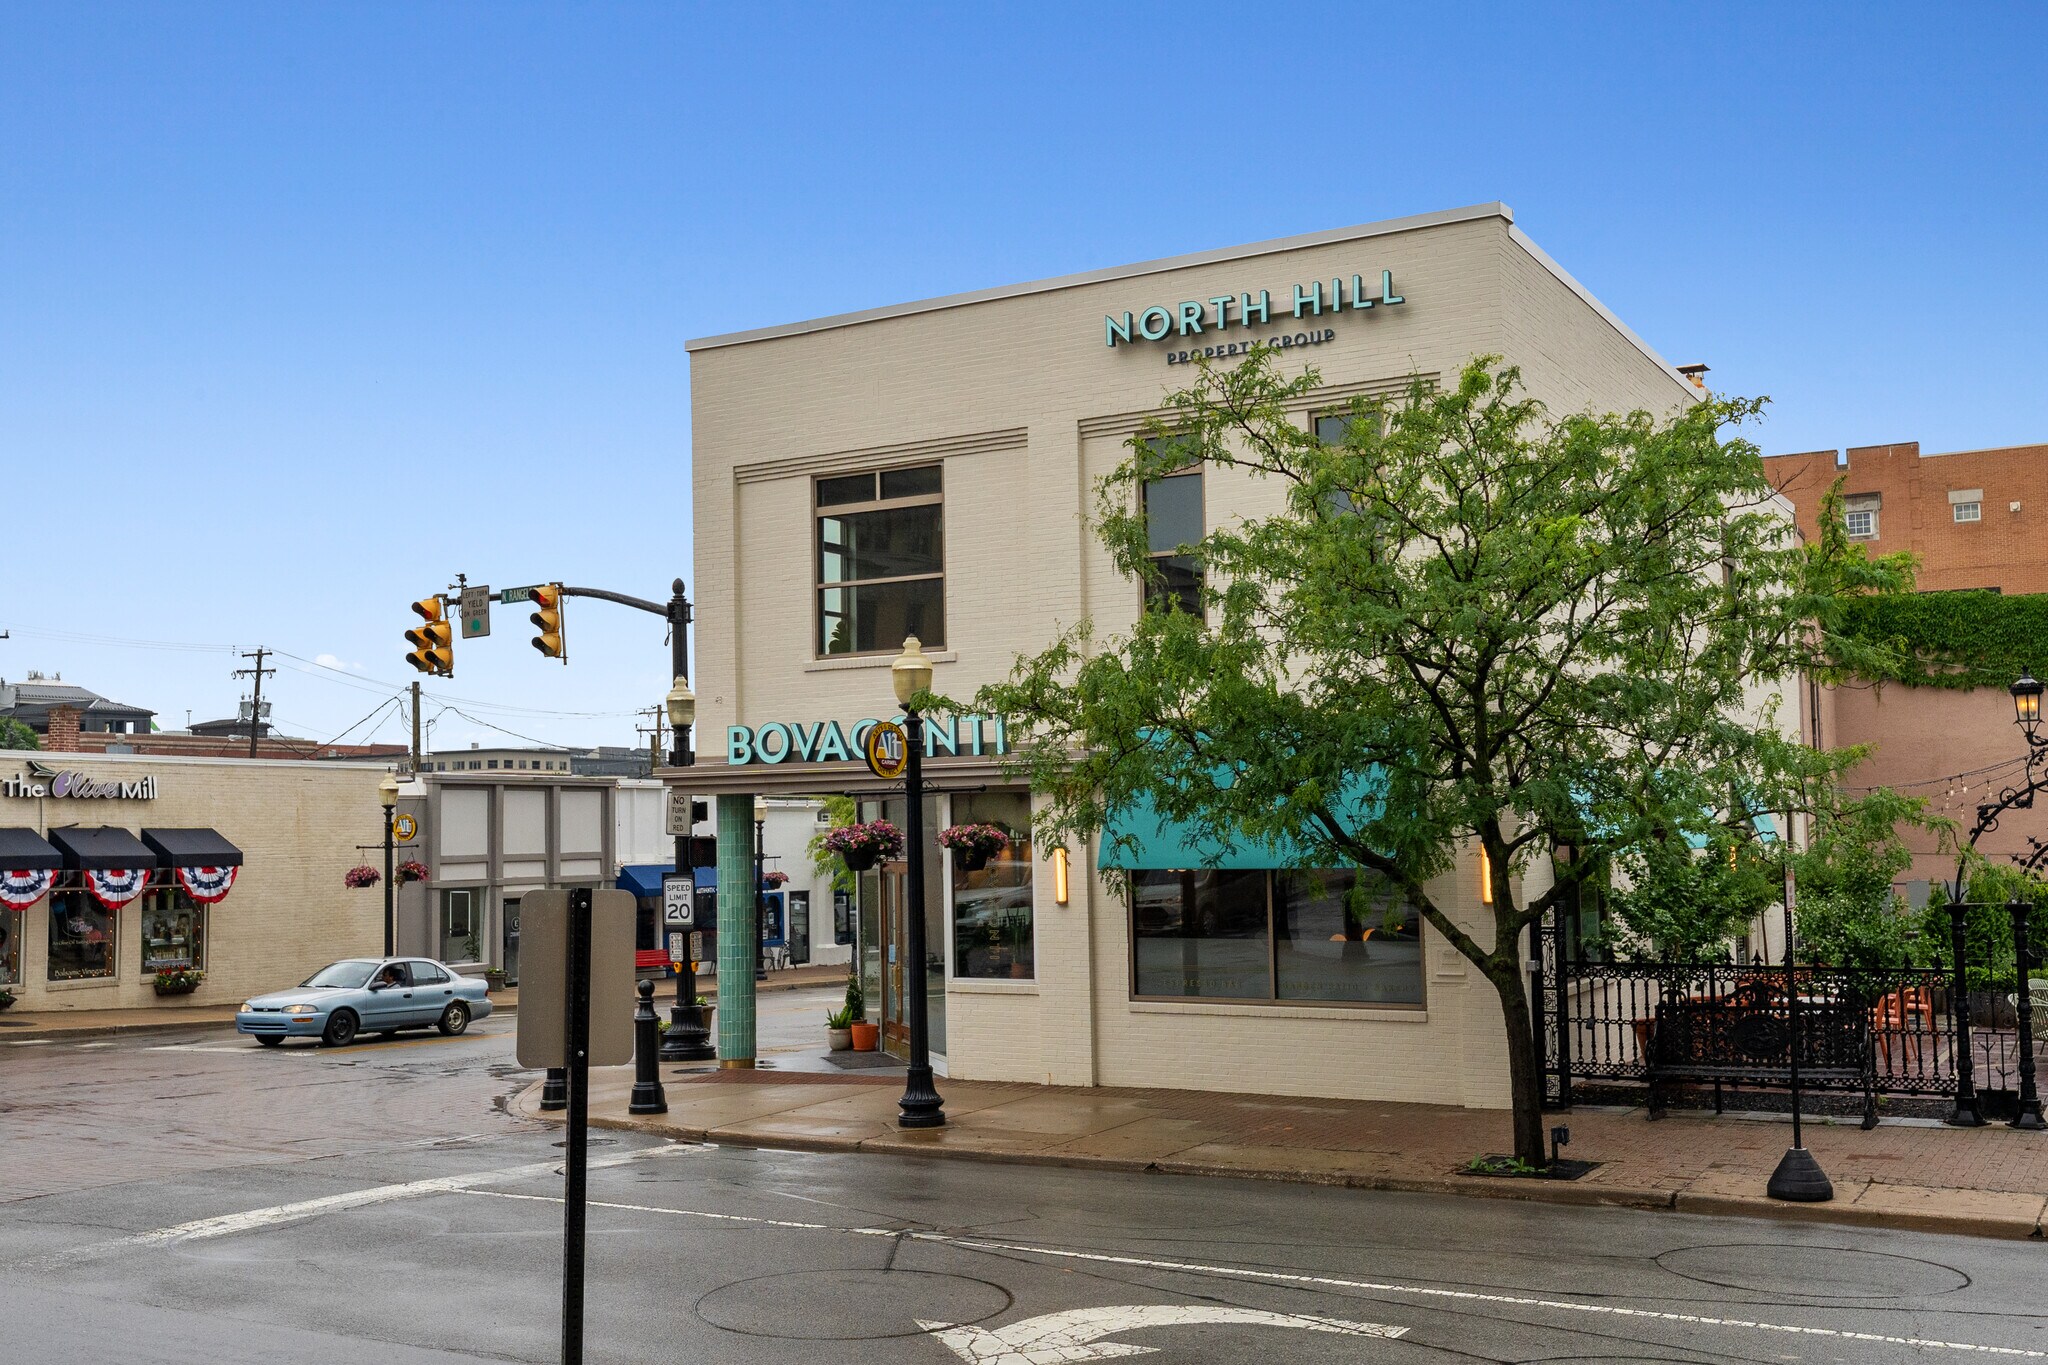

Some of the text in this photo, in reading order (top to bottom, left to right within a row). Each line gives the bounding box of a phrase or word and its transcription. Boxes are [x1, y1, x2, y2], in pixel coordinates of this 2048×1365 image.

[1105, 269, 1406, 348] NORTH HILL
[1167, 328, 1335, 365] PROPERTY GROUP
[502, 587, 533, 602] N RANGEL
[468, 600, 483, 608] YIELD
[878, 766, 899, 776] DISTRICT
[2, 769, 159, 799] The Olive Mill
[668, 903, 690, 919] 20
